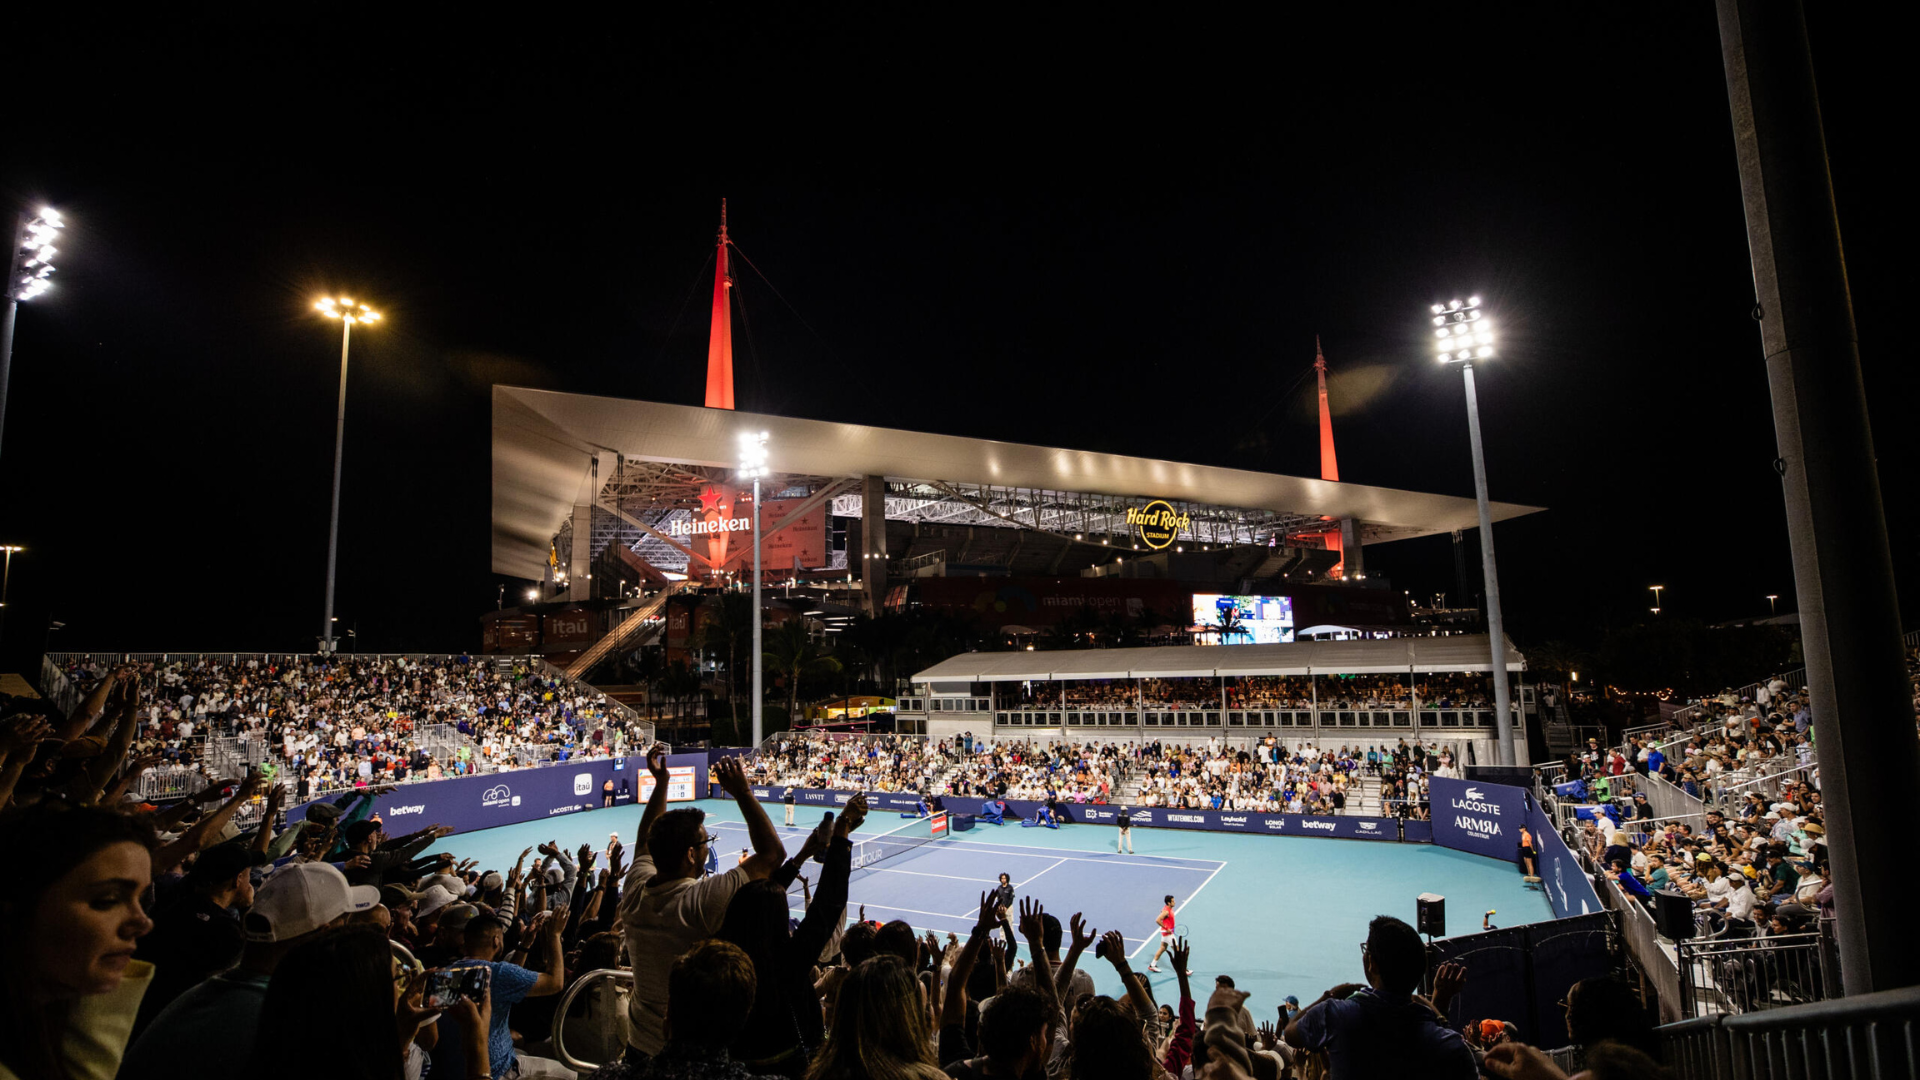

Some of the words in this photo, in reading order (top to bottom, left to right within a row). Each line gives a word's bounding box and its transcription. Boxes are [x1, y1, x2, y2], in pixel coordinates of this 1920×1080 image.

[670, 516, 751, 537] Heineken
[1126, 507, 1160, 526] Hard
[1160, 510, 1190, 532] Rock
[1041, 594, 1084, 607] miami
[1089, 597, 1121, 609] open
[805, 793, 825, 801] LASVIT
[390, 804, 425, 817] betway
[549, 805, 574, 815] LACOSTE
[1452, 798, 1500, 815] LACOSTE
[1302, 819, 1336, 831] betway
[862, 848, 883, 866] TOUR
